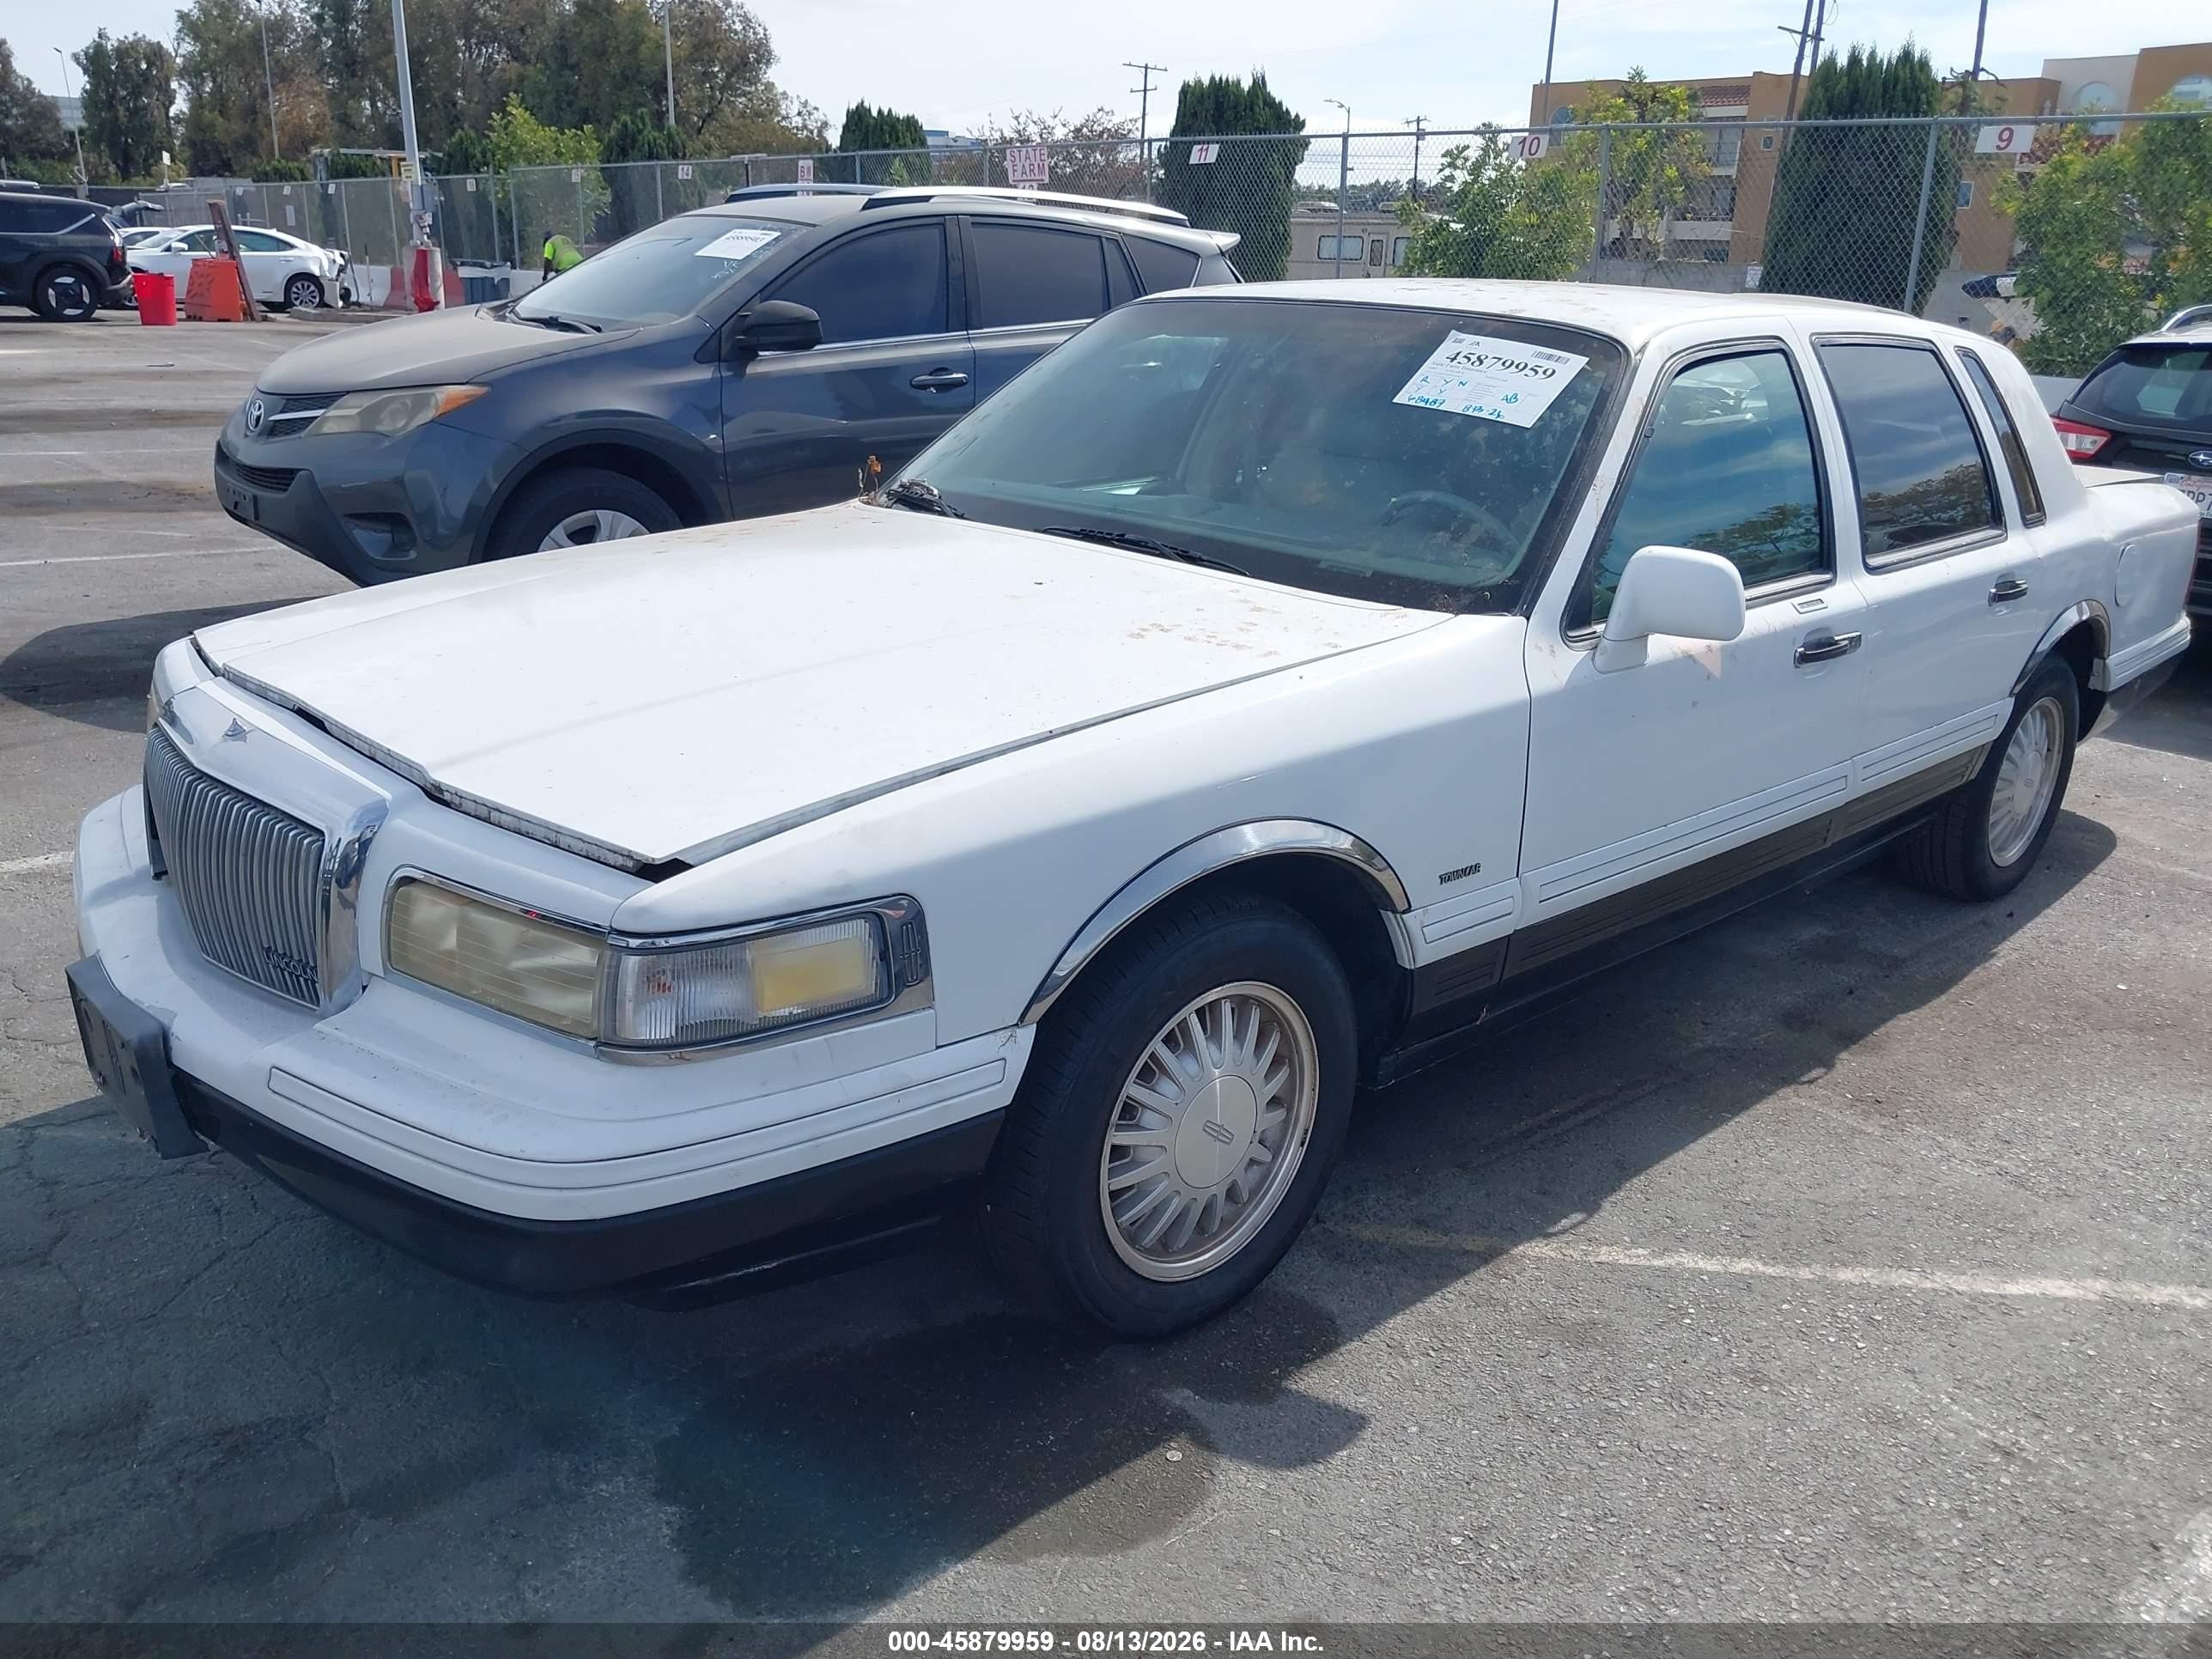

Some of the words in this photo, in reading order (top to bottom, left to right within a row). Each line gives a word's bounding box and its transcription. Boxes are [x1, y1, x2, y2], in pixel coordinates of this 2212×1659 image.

[1517, 136, 1541, 157] 10
[1996, 126, 2014, 151] 9
[1009, 148, 1046, 163] STATE
[1197, 144, 1210, 162] 11
[1012, 163, 1046, 179] FARM
[1445, 350, 1556, 380] 45879959
[263, 949, 318, 982] LINCOLN
